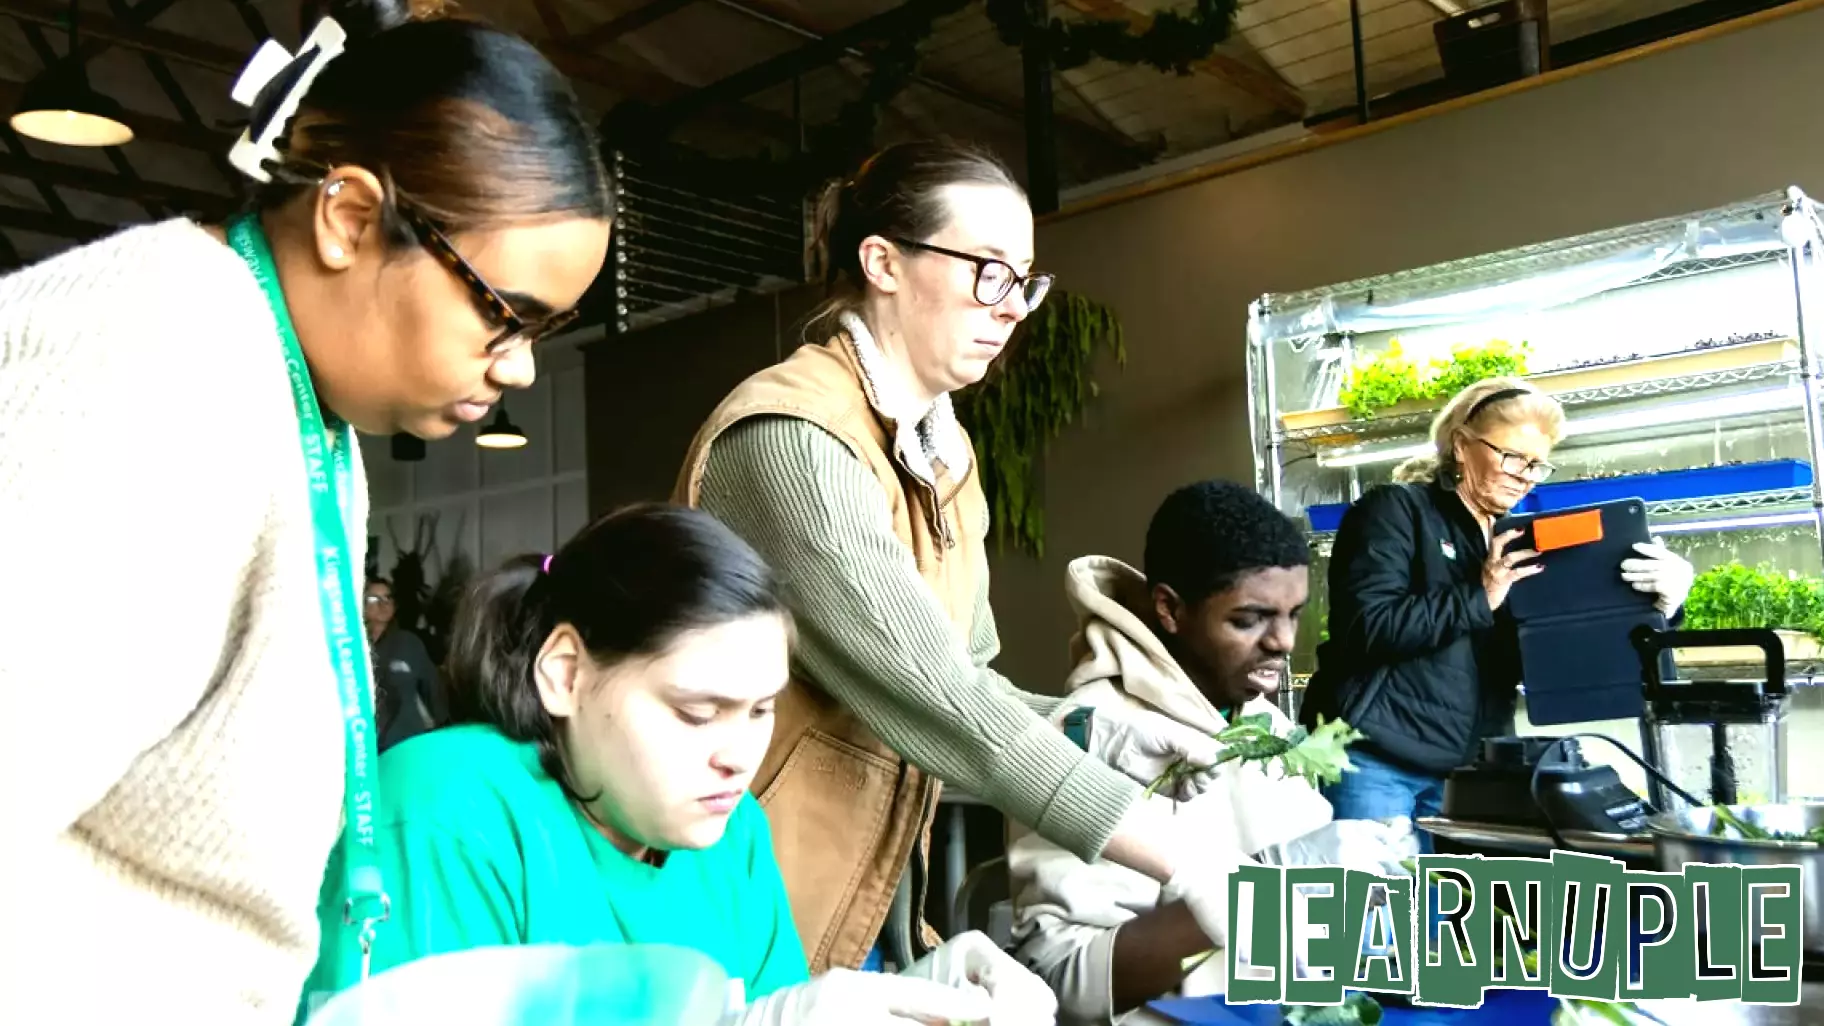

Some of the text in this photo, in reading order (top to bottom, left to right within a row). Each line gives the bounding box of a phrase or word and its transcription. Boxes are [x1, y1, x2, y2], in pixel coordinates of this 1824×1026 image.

[286, 358, 313, 419] Center
[305, 433, 328, 492] STAFF
[352, 717, 367, 777] Center
[355, 790, 373, 846] STAFF
